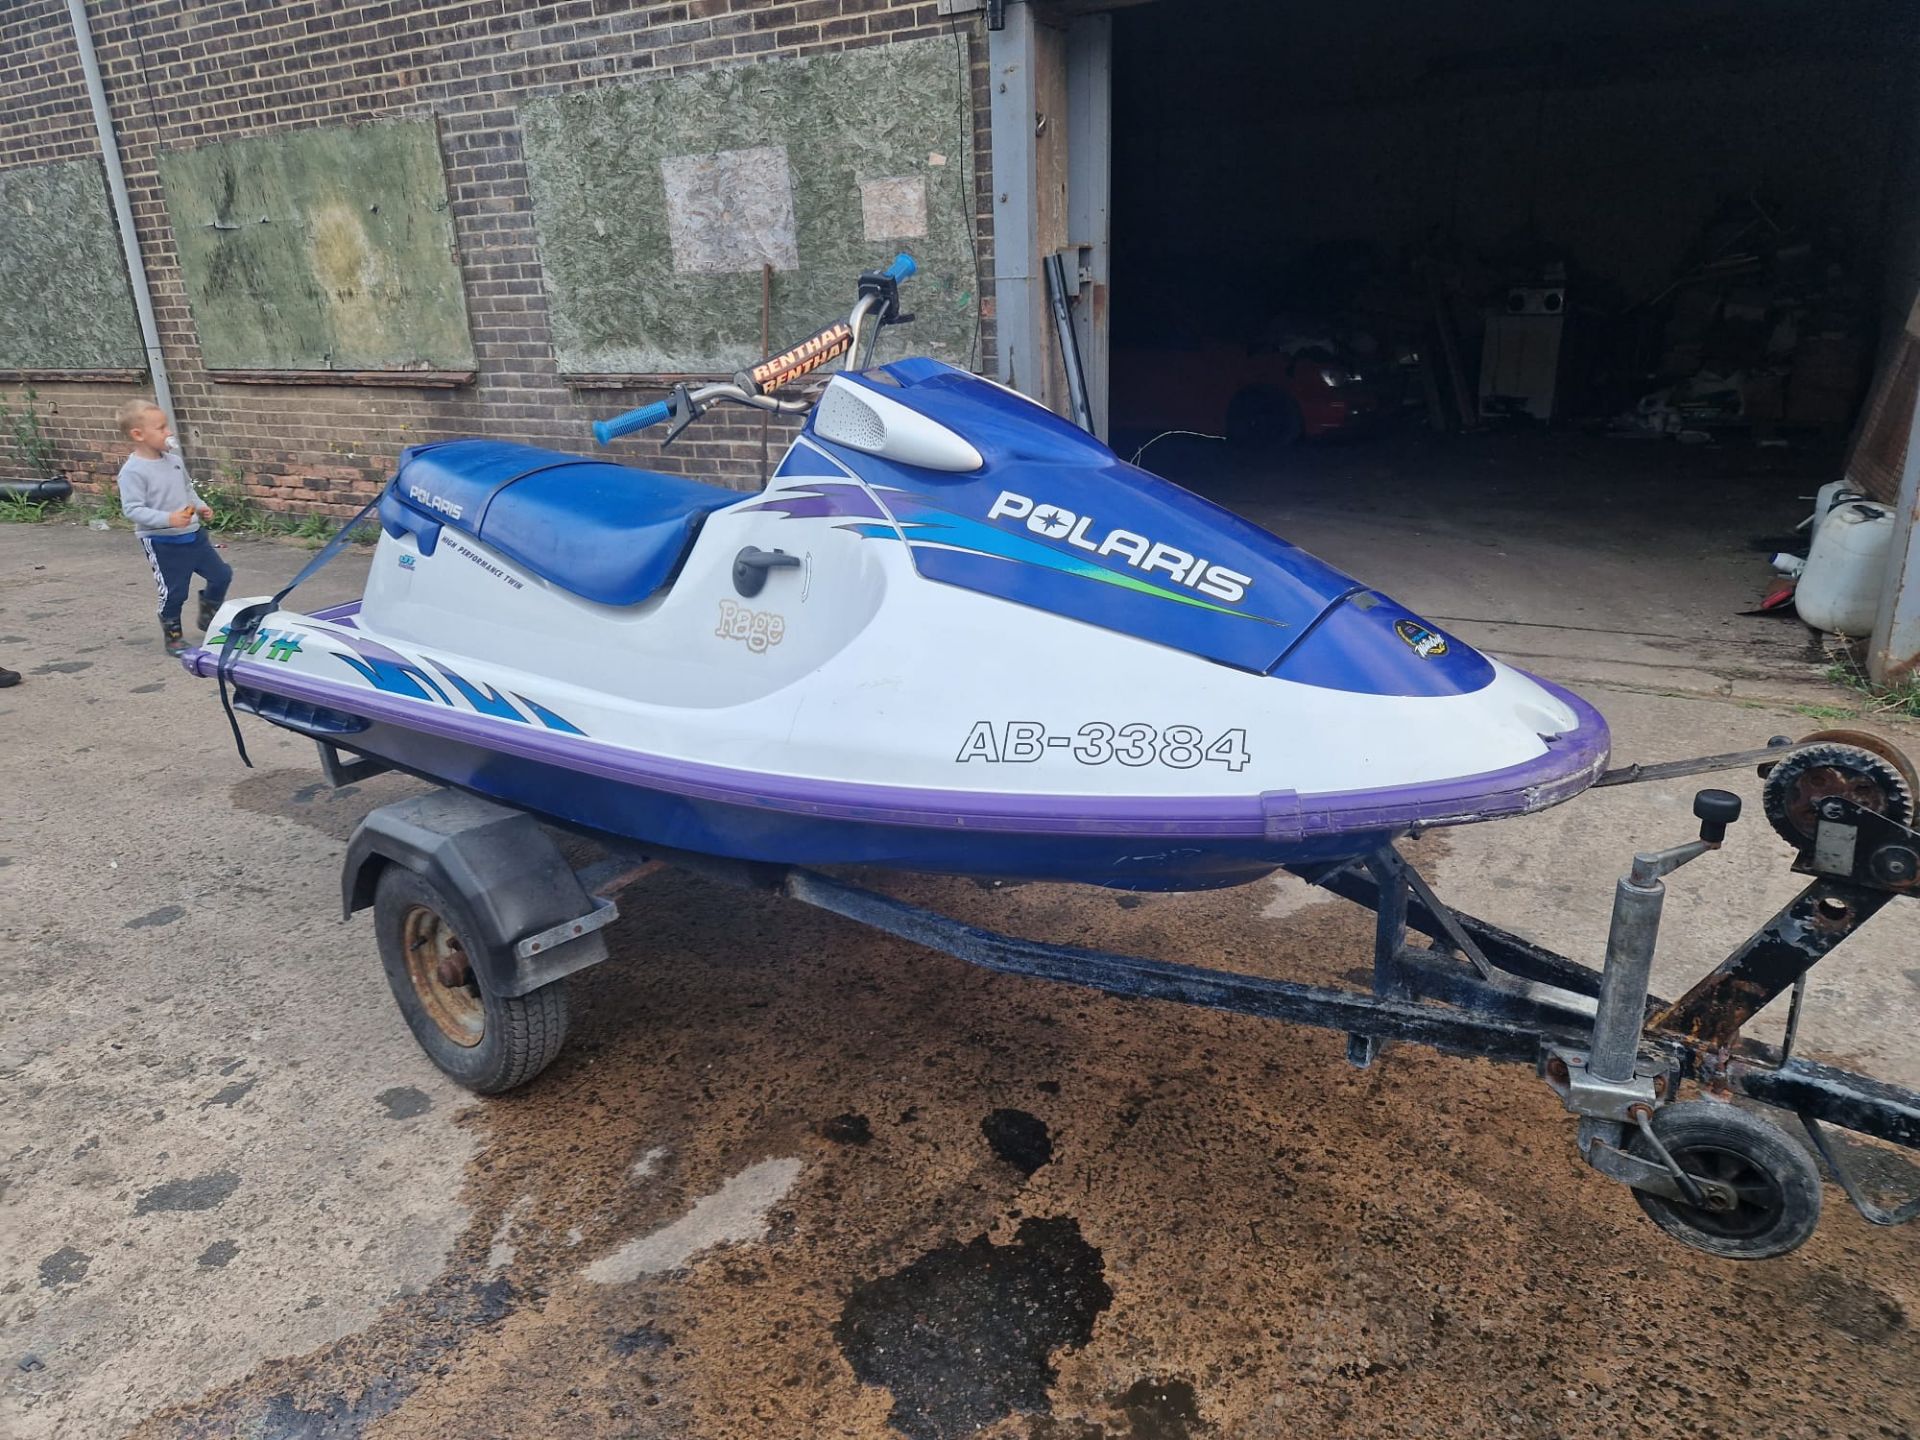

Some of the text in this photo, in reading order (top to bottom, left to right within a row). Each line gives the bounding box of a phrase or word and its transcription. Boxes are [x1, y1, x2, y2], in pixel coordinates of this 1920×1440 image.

[753, 324, 849, 384] RENTHAL
[409, 485, 463, 520] POLARIS
[441, 536, 525, 590] HIGH PERFORMANCE TWIN
[987, 490, 1253, 602] POLARIS
[715, 599, 786, 654] Rage
[955, 721, 1251, 772] AB-3384
